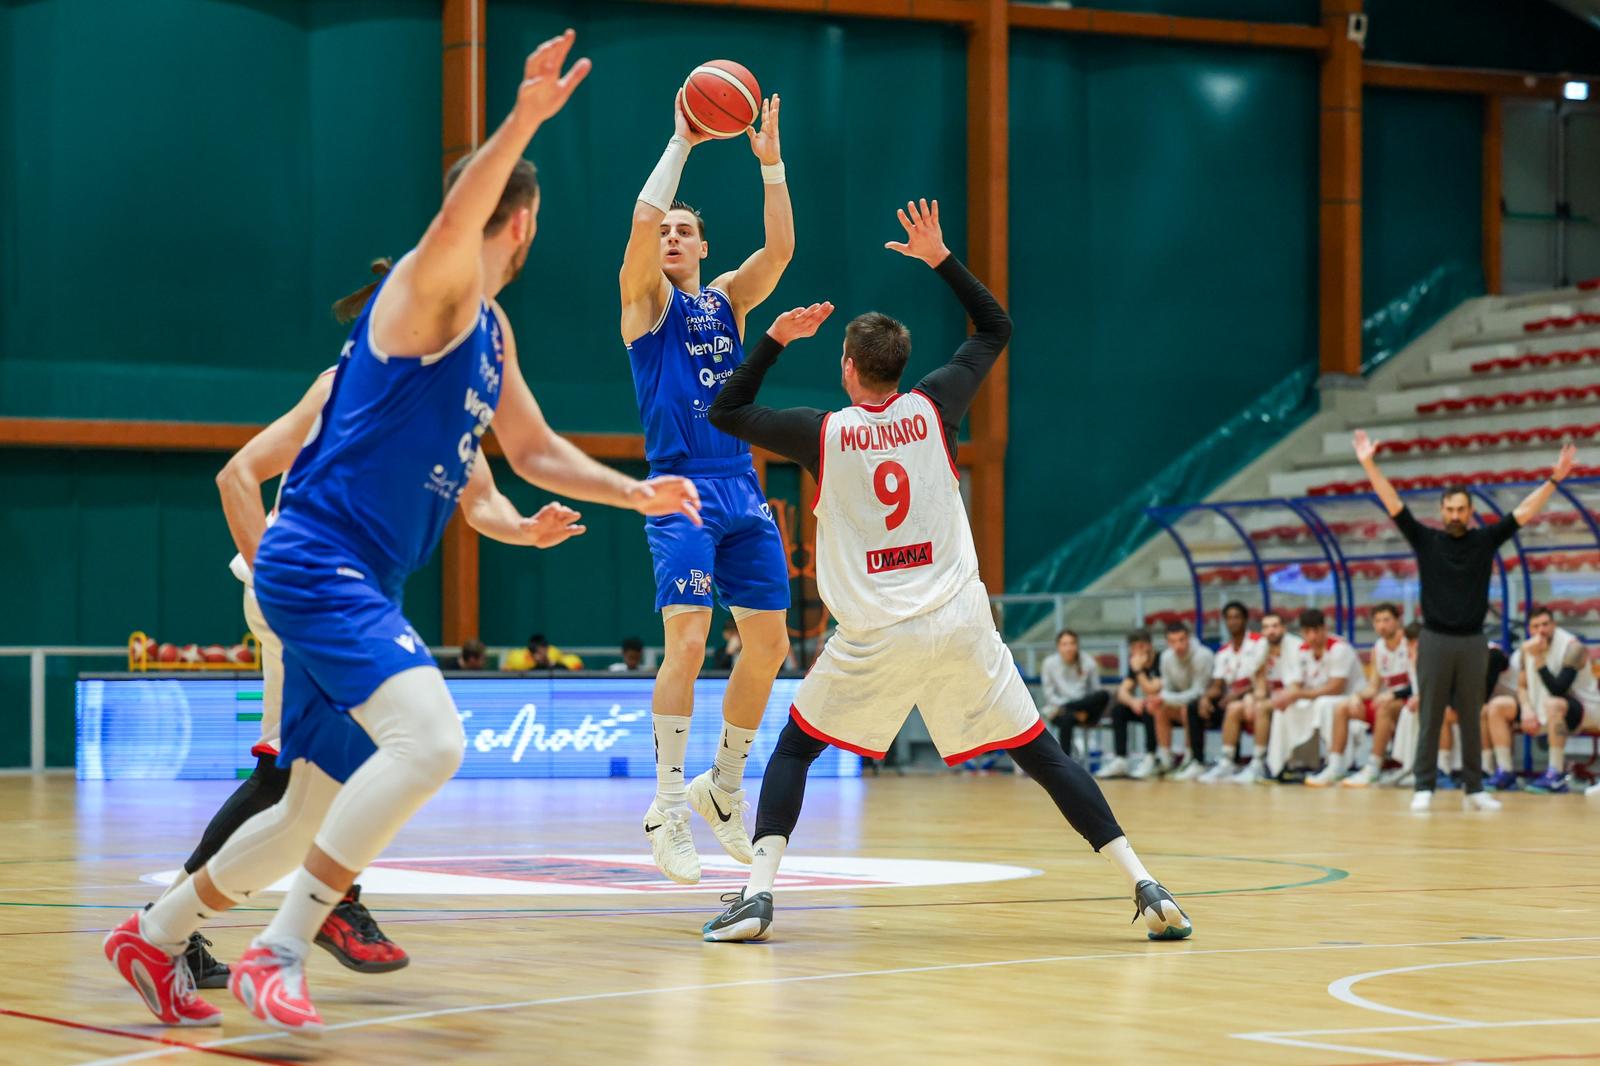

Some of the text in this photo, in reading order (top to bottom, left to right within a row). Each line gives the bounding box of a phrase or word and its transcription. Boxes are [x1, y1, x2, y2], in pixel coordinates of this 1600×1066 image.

[840, 414, 928, 452] MOLINARO
[873, 460, 911, 532] 9
[870, 547, 928, 570] UMANA
